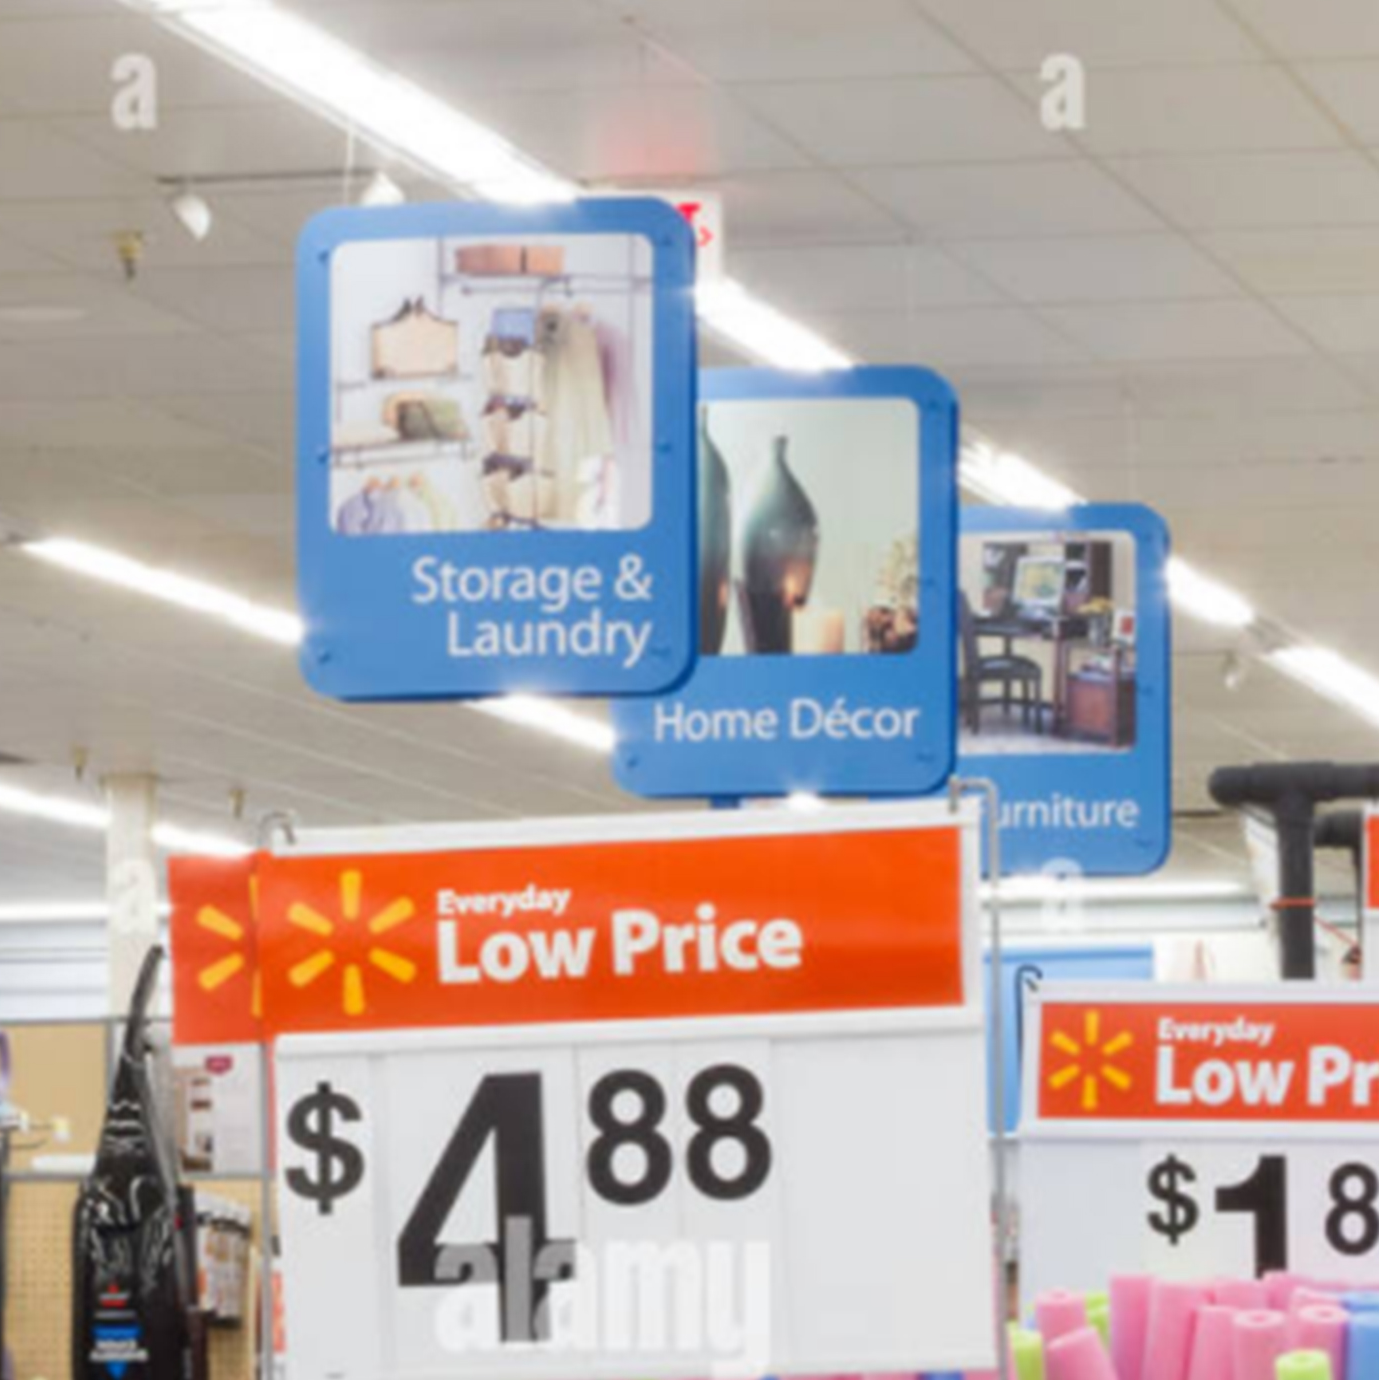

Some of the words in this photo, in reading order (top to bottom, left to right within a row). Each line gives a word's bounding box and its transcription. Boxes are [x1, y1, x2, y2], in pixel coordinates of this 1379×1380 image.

[412, 555, 603, 612] Storage
[615, 555, 653, 601] &
[447, 609, 653, 668] Laundry
[654, 703, 778, 741] Home
[790, 696, 920, 739] Décor
[998, 792, 1141, 829] urniture
[437, 885, 571, 915] Everyday
[437, 919, 594, 983] Low
[611, 903, 804, 976] Price
[1157, 1017, 1276, 1046] Everyday
[1155, 1045, 1294, 1105] Low
[1306, 1045, 1379, 1106] Pr
